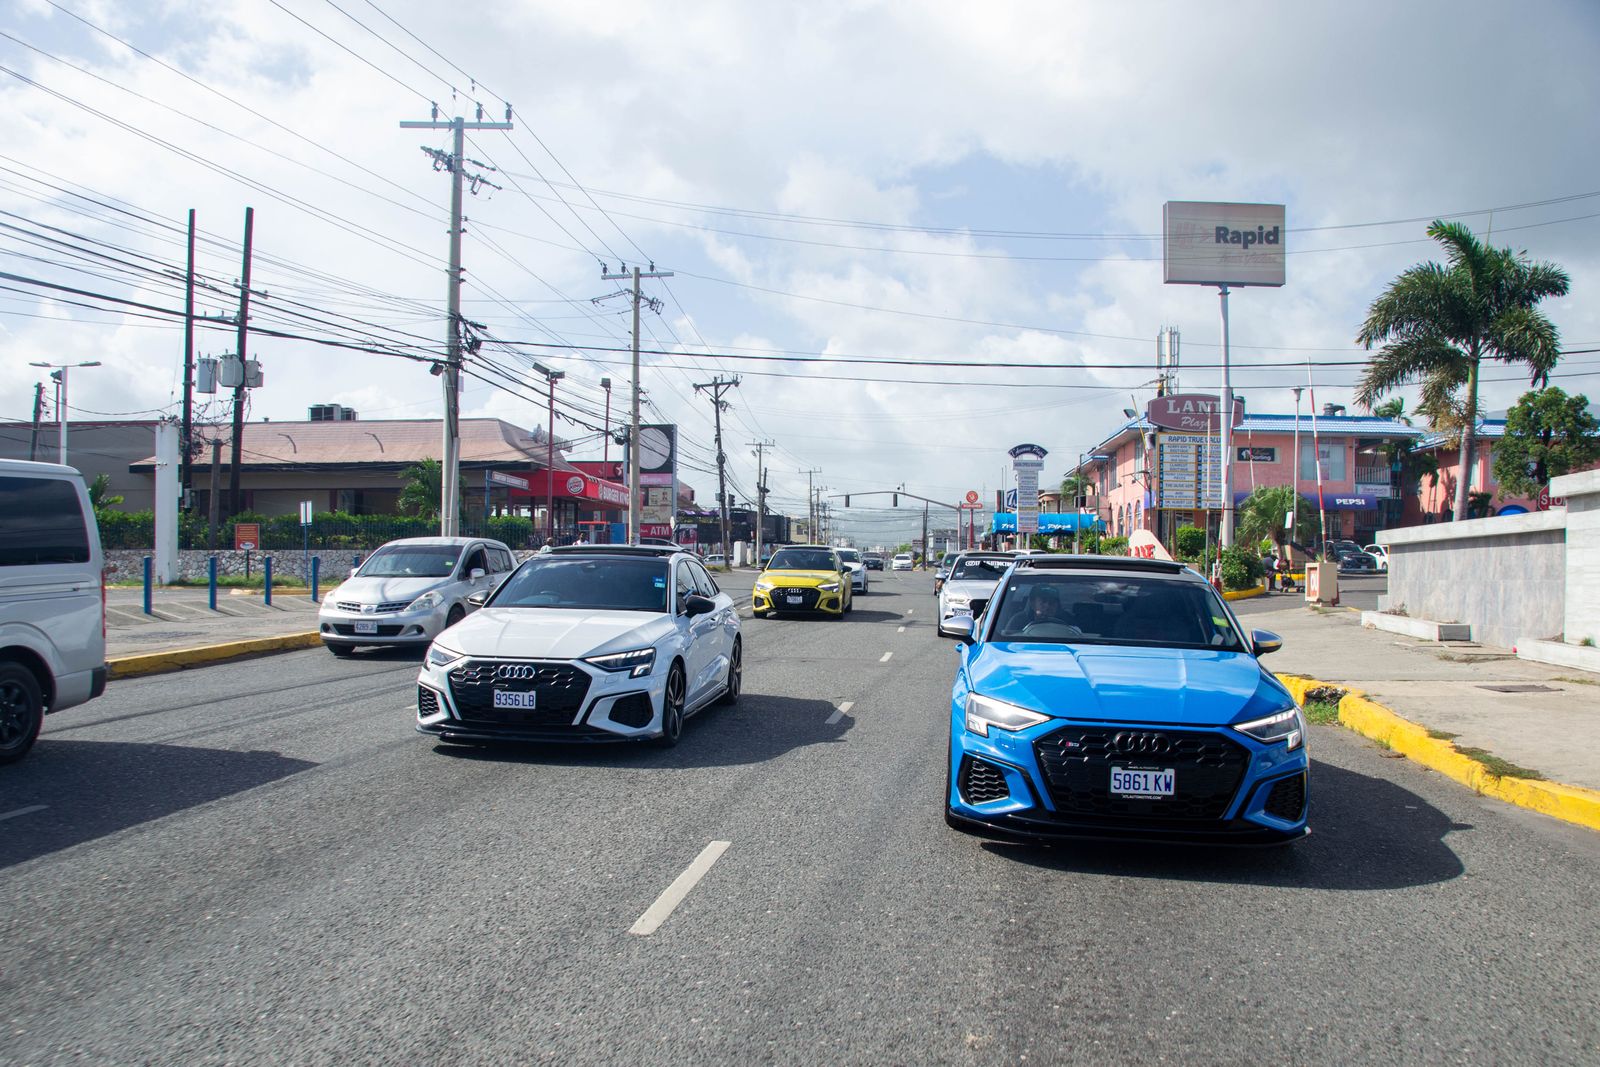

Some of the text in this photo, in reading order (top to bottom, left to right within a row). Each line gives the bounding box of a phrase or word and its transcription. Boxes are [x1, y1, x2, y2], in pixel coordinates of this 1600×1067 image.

[1215, 225, 1279, 249] Rapid
[650, 526, 669, 535] ATM
[495, 693, 534, 707] 9356 LB
[1113, 773, 1172, 792] 5861 KW
